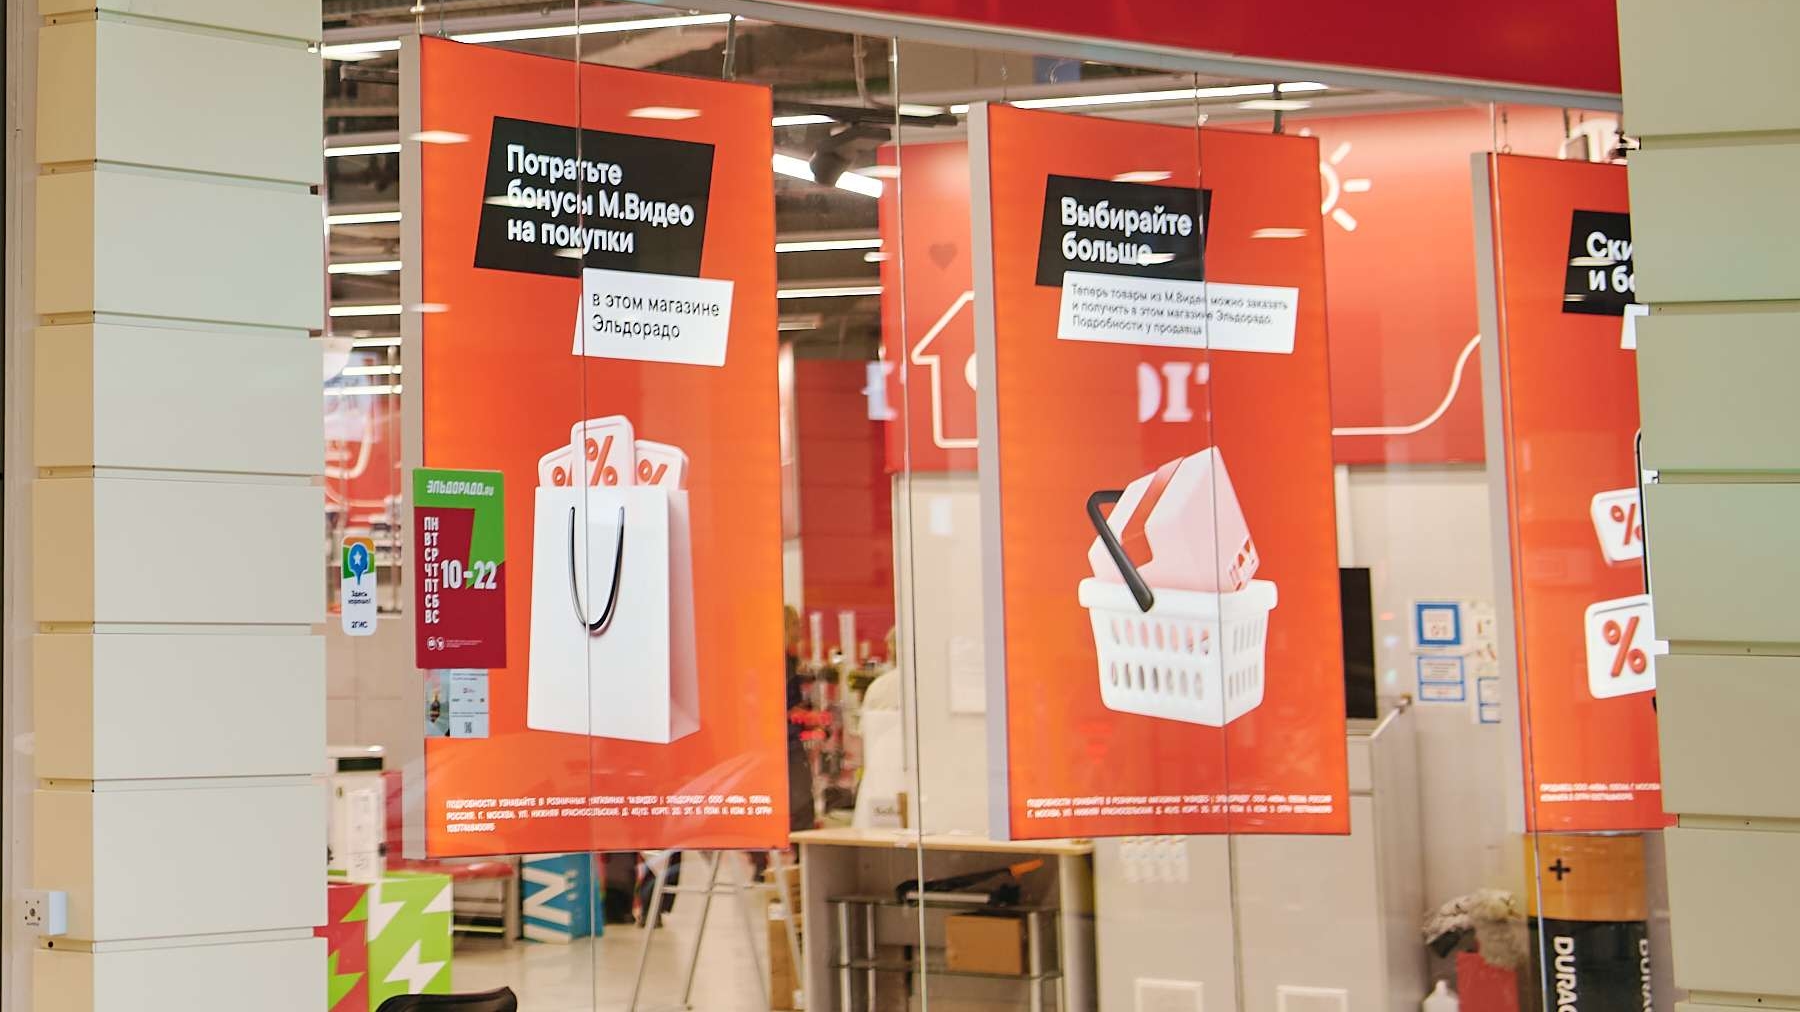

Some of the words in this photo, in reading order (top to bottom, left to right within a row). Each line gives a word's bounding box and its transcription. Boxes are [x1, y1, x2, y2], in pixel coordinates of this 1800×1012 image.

[507, 144, 623, 186] Потратьте
[507, 179, 593, 217] бонусы
[599, 190, 695, 228] М.Видео
[1061, 196, 1192, 237] Выбирайте
[507, 219, 535, 244] на
[541, 222, 634, 255] покупки
[1062, 231, 1153, 266] больше
[1589, 269, 1606, 291] и
[592, 294, 600, 307] в
[605, 294, 643, 311] этом
[648, 297, 720, 317] магазине
[592, 314, 680, 340] Эльдорадо
[424, 516, 439, 530] ПН
[424, 532, 439, 546] ВТ
[424, 547, 439, 562] СР
[424, 562, 439, 577] ЧТ
[441, 559, 497, 590] 10-22
[424, 578, 439, 593] ПТ
[424, 594, 440, 609] СБ
[424, 609, 440, 624] ВС
